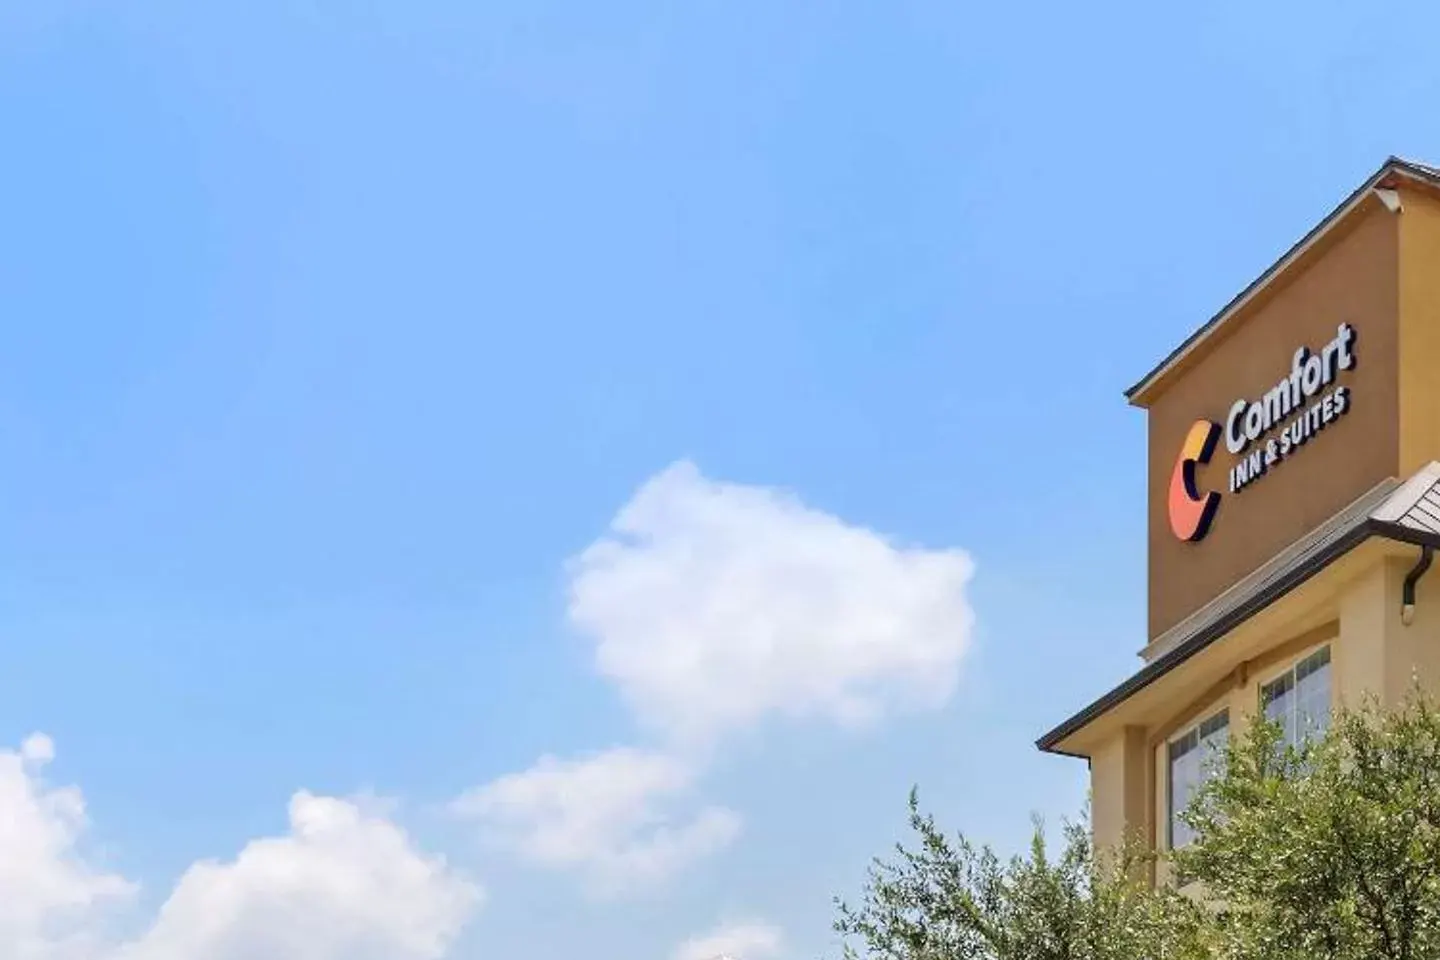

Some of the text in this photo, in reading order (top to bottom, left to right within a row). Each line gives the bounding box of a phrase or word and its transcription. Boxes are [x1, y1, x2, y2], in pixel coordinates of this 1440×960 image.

[1226, 322, 1354, 454] Comfort
[1230, 386, 1348, 493] INN & SUITES
